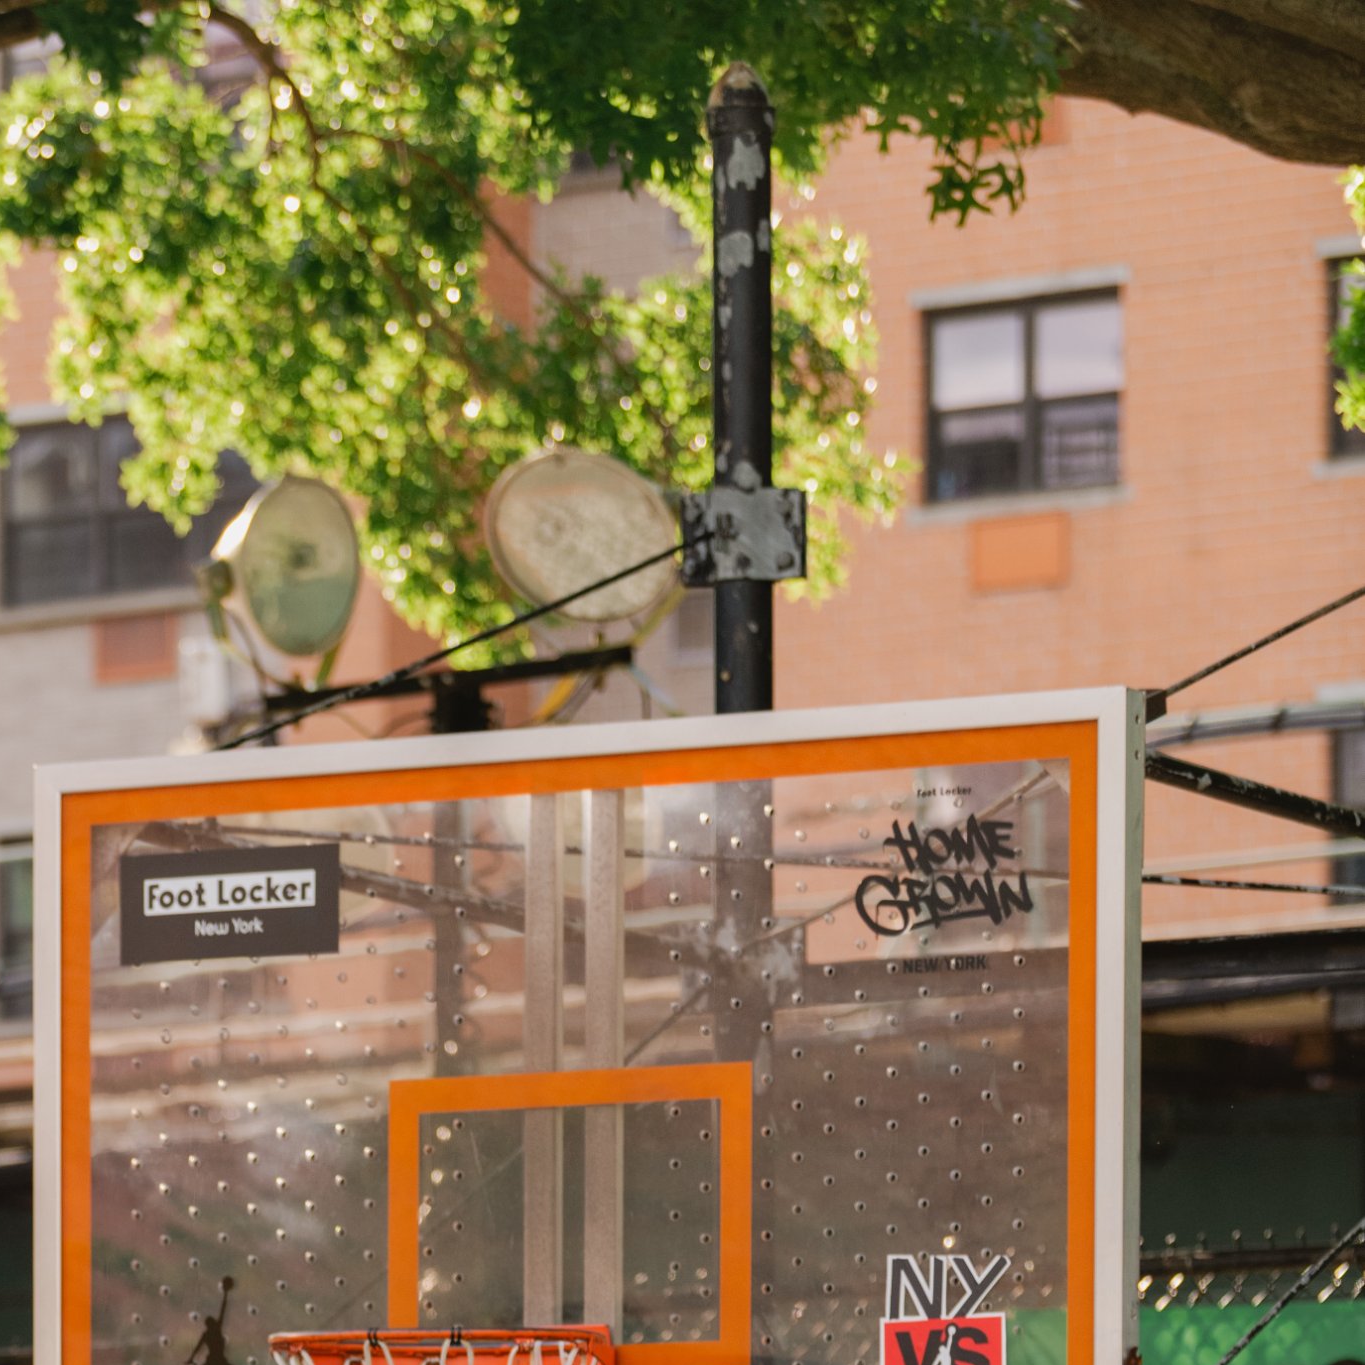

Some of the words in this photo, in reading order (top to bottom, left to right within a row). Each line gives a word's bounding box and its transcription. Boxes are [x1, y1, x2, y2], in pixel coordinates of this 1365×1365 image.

[917, 789, 936, 798] Foot
[941, 786, 972, 796] Locker
[883, 813, 1015, 875] HOME
[147, 882, 206, 910] Foot
[218, 876, 311, 905] Locker
[855, 869, 1034, 936] GROWN
[194, 919, 229, 937] New
[232, 916, 264, 934] York
[903, 958, 938, 974] NEW
[944, 955, 988, 971] YORK
[886, 1254, 1011, 1320] NY
